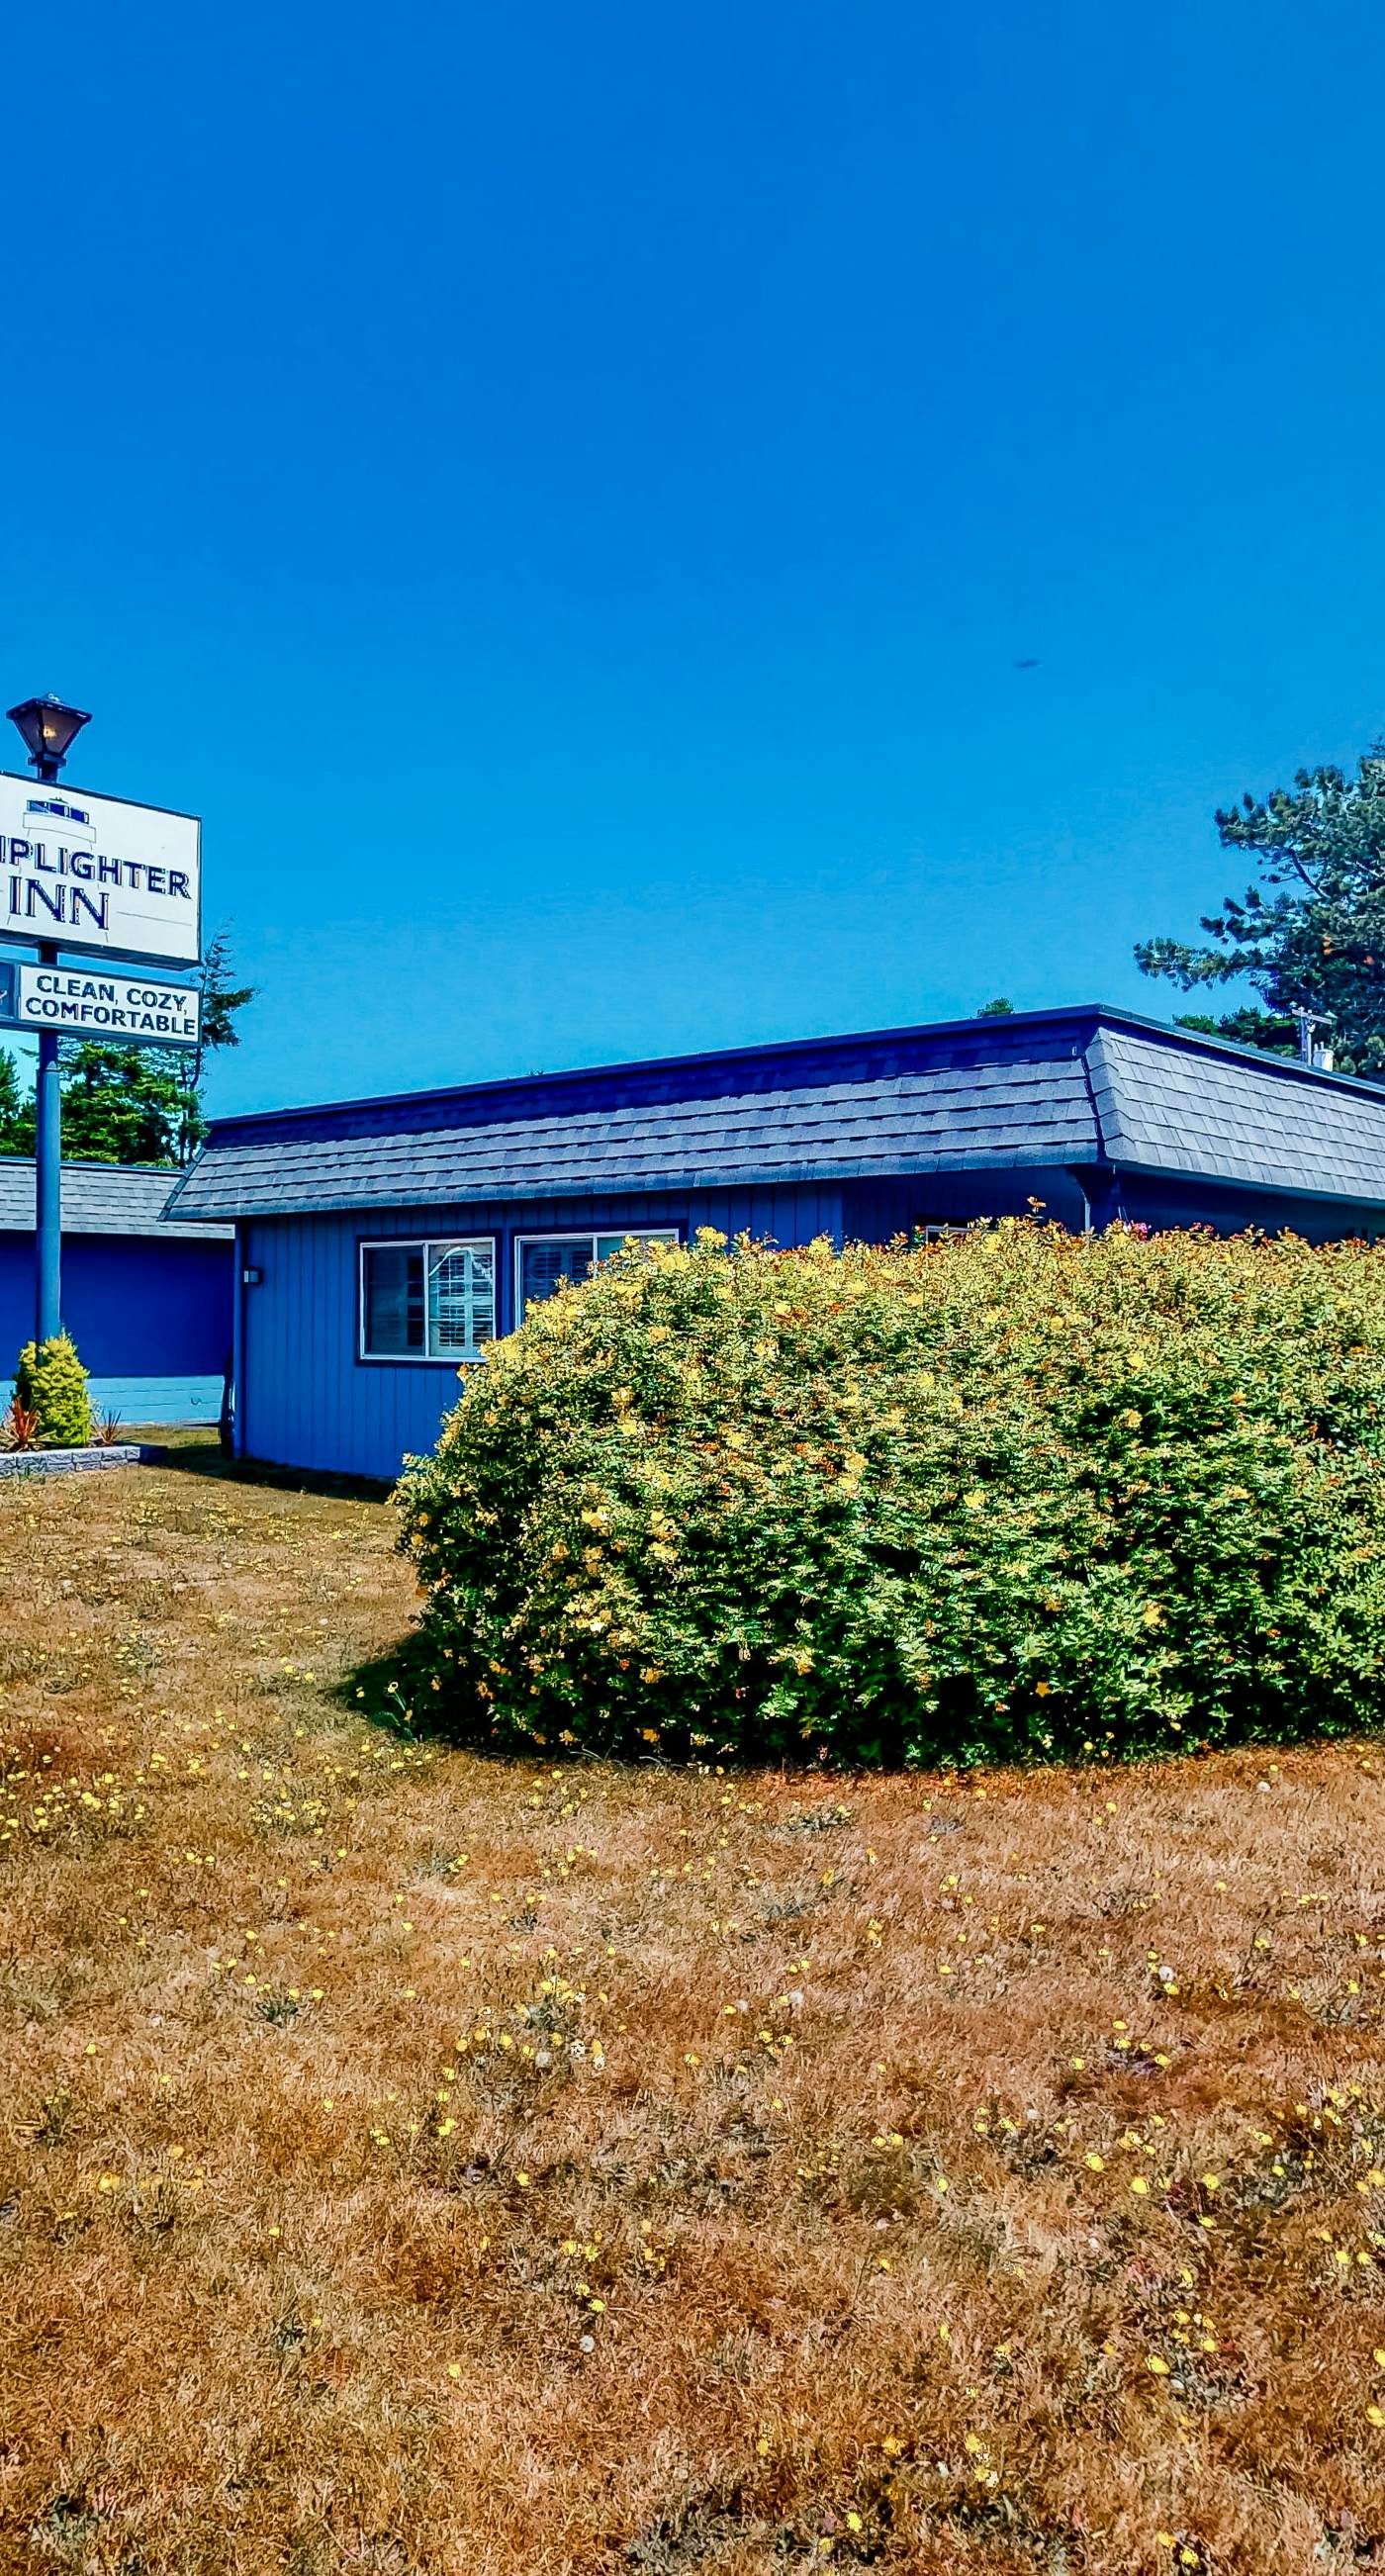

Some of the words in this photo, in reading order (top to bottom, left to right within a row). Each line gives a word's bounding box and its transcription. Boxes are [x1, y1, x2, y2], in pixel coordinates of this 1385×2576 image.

[0, 835, 191, 899] PLIGHTER
[9, 874, 110, 930] INN
[26, 997, 195, 1035] COMFORTABLE
[37, 974, 119, 1006] CLEAN,
[127, 988, 188, 1015] COZY,
